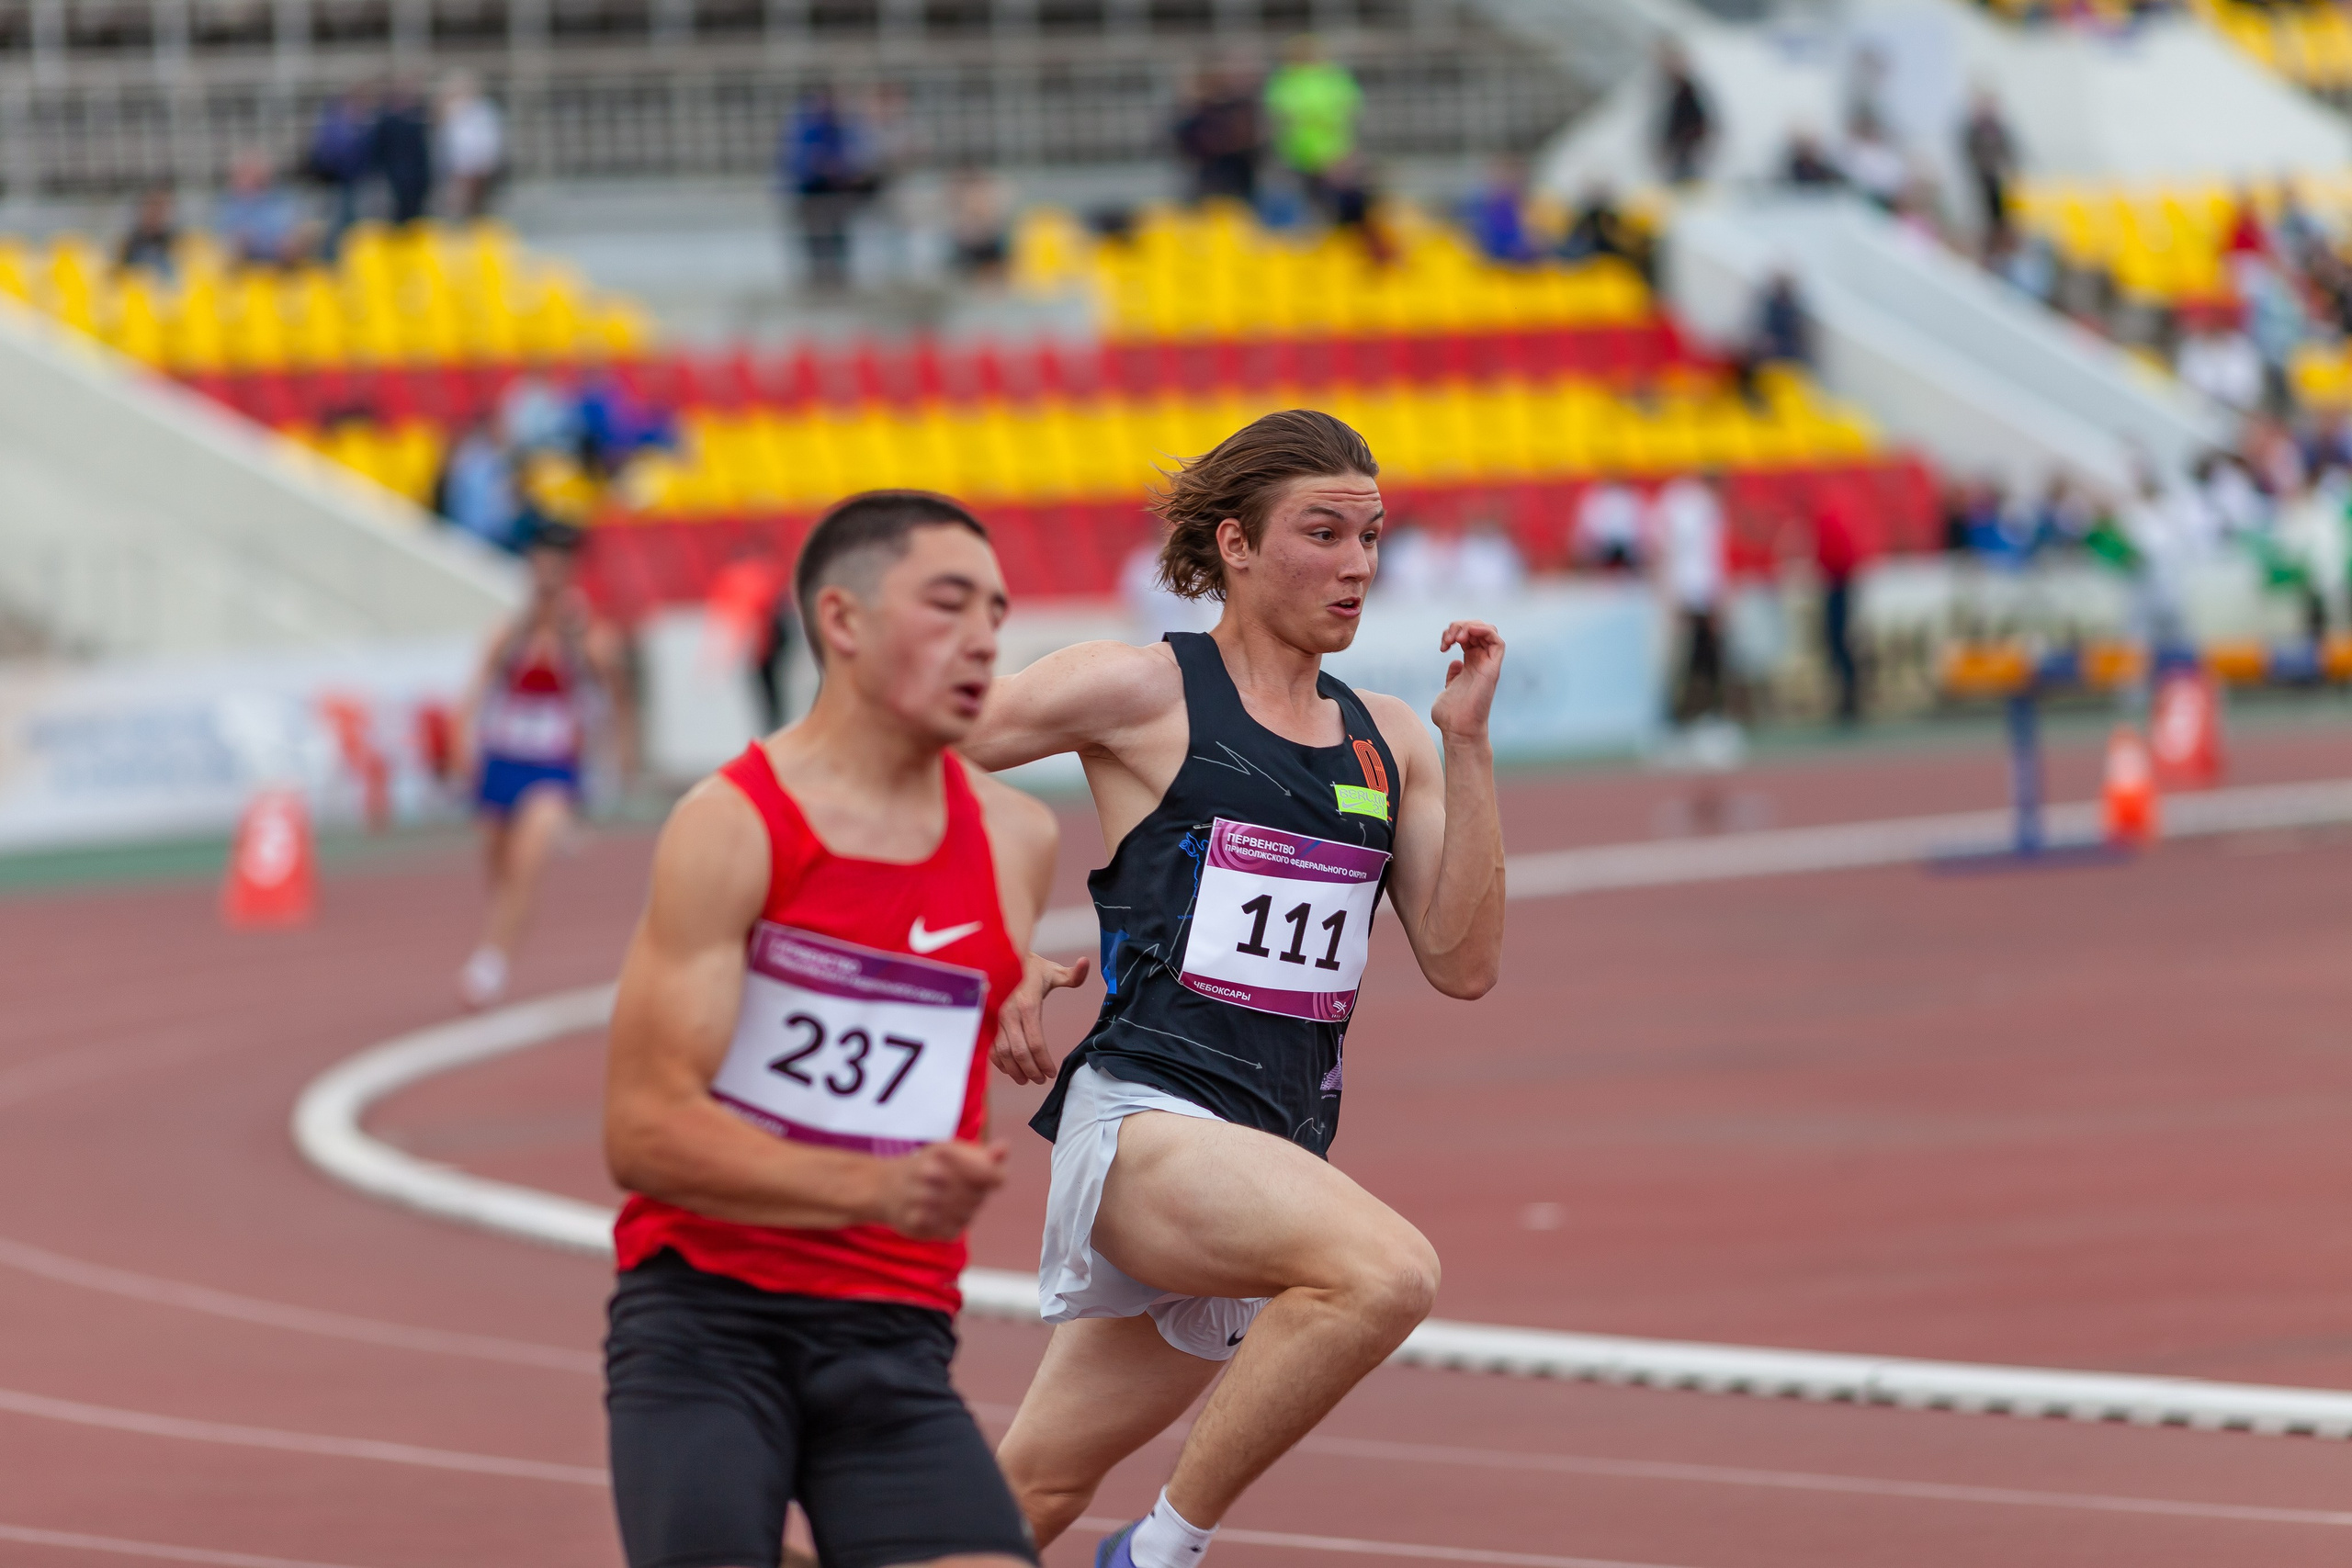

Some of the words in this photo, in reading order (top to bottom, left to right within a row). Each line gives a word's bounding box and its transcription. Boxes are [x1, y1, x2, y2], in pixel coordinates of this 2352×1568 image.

[1339, 788, 1385, 806] BERLIN
[1227, 832, 1295, 855] ПЕРВЕНСТВО
[1225, 843, 1289, 864] ПРИВОЛЖСКОГО
[1290, 858, 1348, 876] ФЕДЕРАЛЬНОГО
[1236, 894, 1348, 971] 111
[1193, 980, 1251, 1001] ЧЕБОКСАРЫ
[767, 1012, 925, 1105] 237
